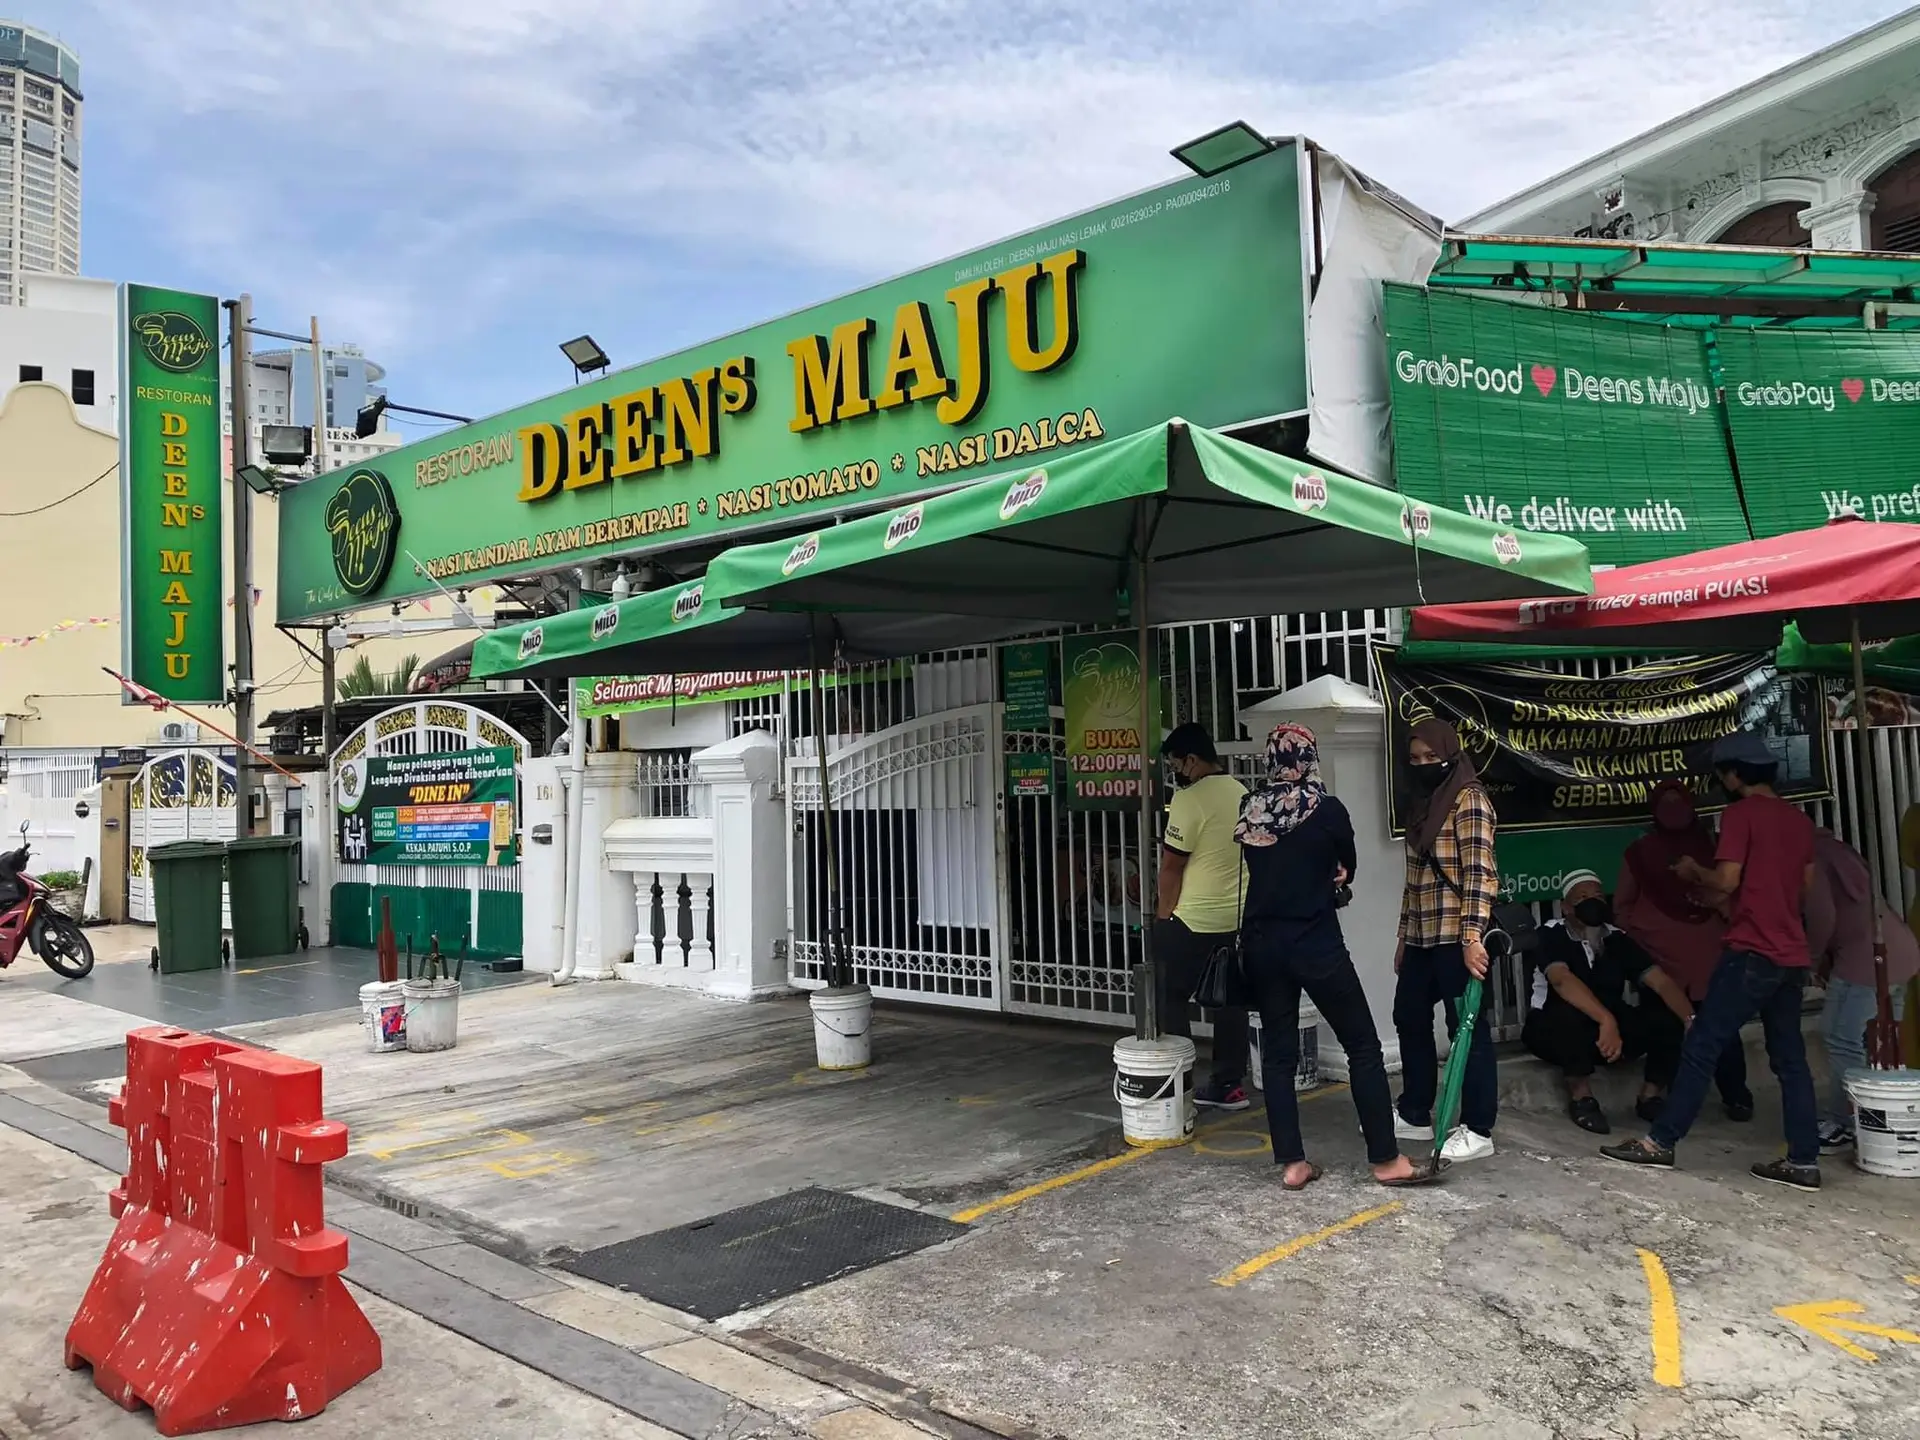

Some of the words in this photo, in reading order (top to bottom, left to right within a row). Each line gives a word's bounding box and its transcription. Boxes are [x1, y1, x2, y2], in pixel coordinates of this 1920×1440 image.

[984, 256, 1004, 273] OLEH
[1008, 245, 1035, 264] DEENS
[1036, 238, 1058, 255] MAJU
[1059, 231, 1079, 248] NASI
[1079, 220, 1108, 240] LEMAK
[1110, 201, 1162, 230] 002162903-P
[1165, 179, 1231, 211] PA000094/2018
[787, 249, 1087, 433] MAJU
[136, 385, 213, 406] RESTORAN
[1395, 350, 1524, 396] GrabFood
[1563, 366, 1644, 406] Deens
[1646, 376, 1712, 416] Maju
[1737, 380, 1836, 412] GrabPay
[415, 428, 513, 489] RESTORAN
[425, 556, 460, 581] NASI
[462, 538, 530, 572] KANDAR
[531, 525, 583, 556] AYAM
[583, 500, 691, 546] BEREMPAH
[716, 483, 772, 522] NASI
[774, 459, 881, 506] TOMATO
[916, 435, 990, 477] NASI
[992, 407, 1106, 461] DALCA
[1003, 483, 1043, 512] MILO
[1294, 482, 1325, 501] MILO
[1820, 489, 1866, 519] We
[1402, 512, 1429, 531] MILO
[1463, 494, 1513, 527] We
[1521, 497, 1618, 532] deliver
[1623, 499, 1688, 533] with
[887, 516, 922, 543] MILO
[785, 544, 817, 569] MILO
[1494, 540, 1520, 557] MILO
[675, 592, 702, 615] MILO
[1639, 584, 1701, 608] sampai
[1704, 575, 1770, 600] PUAS!
[159, 549, 193, 680] MAJU
[594, 612, 617, 634] MILO
[522, 633, 542, 655] MILO
[593, 676, 654, 702] Selamat
[1545, 682, 1615, 700] HARAP
[1616, 674, 1698, 698] MAKLUM
[1511, 700, 1560, 723] SILA
[1560, 703, 1612, 721] BUAT
[1613, 689, 1739, 722] PEMBAYARAN
[1085, 729, 1140, 750] BUKA
[1507, 727, 1614, 752] MAKANAN
[1616, 725, 1658, 748] DAN
[1658, 714, 1739, 745] MINUMAN
[386, 759, 410, 773] Hanya
[411, 756, 451, 772] pelanggan
[452, 755, 472, 769] yang
[473, 752, 495, 764] telah
[1070, 754, 1141, 773] 12.00PM
[1573, 755, 1595, 778] DI
[1596, 748, 1688, 778] KAUNTER
[371, 773, 403, 787] Lengkap
[404, 770, 436, 784] Divaksin
[437, 768, 464, 782] sahaja
[1552, 781, 1648, 808] SEBELUM
[405, 841, 426, 853] KEKAL
